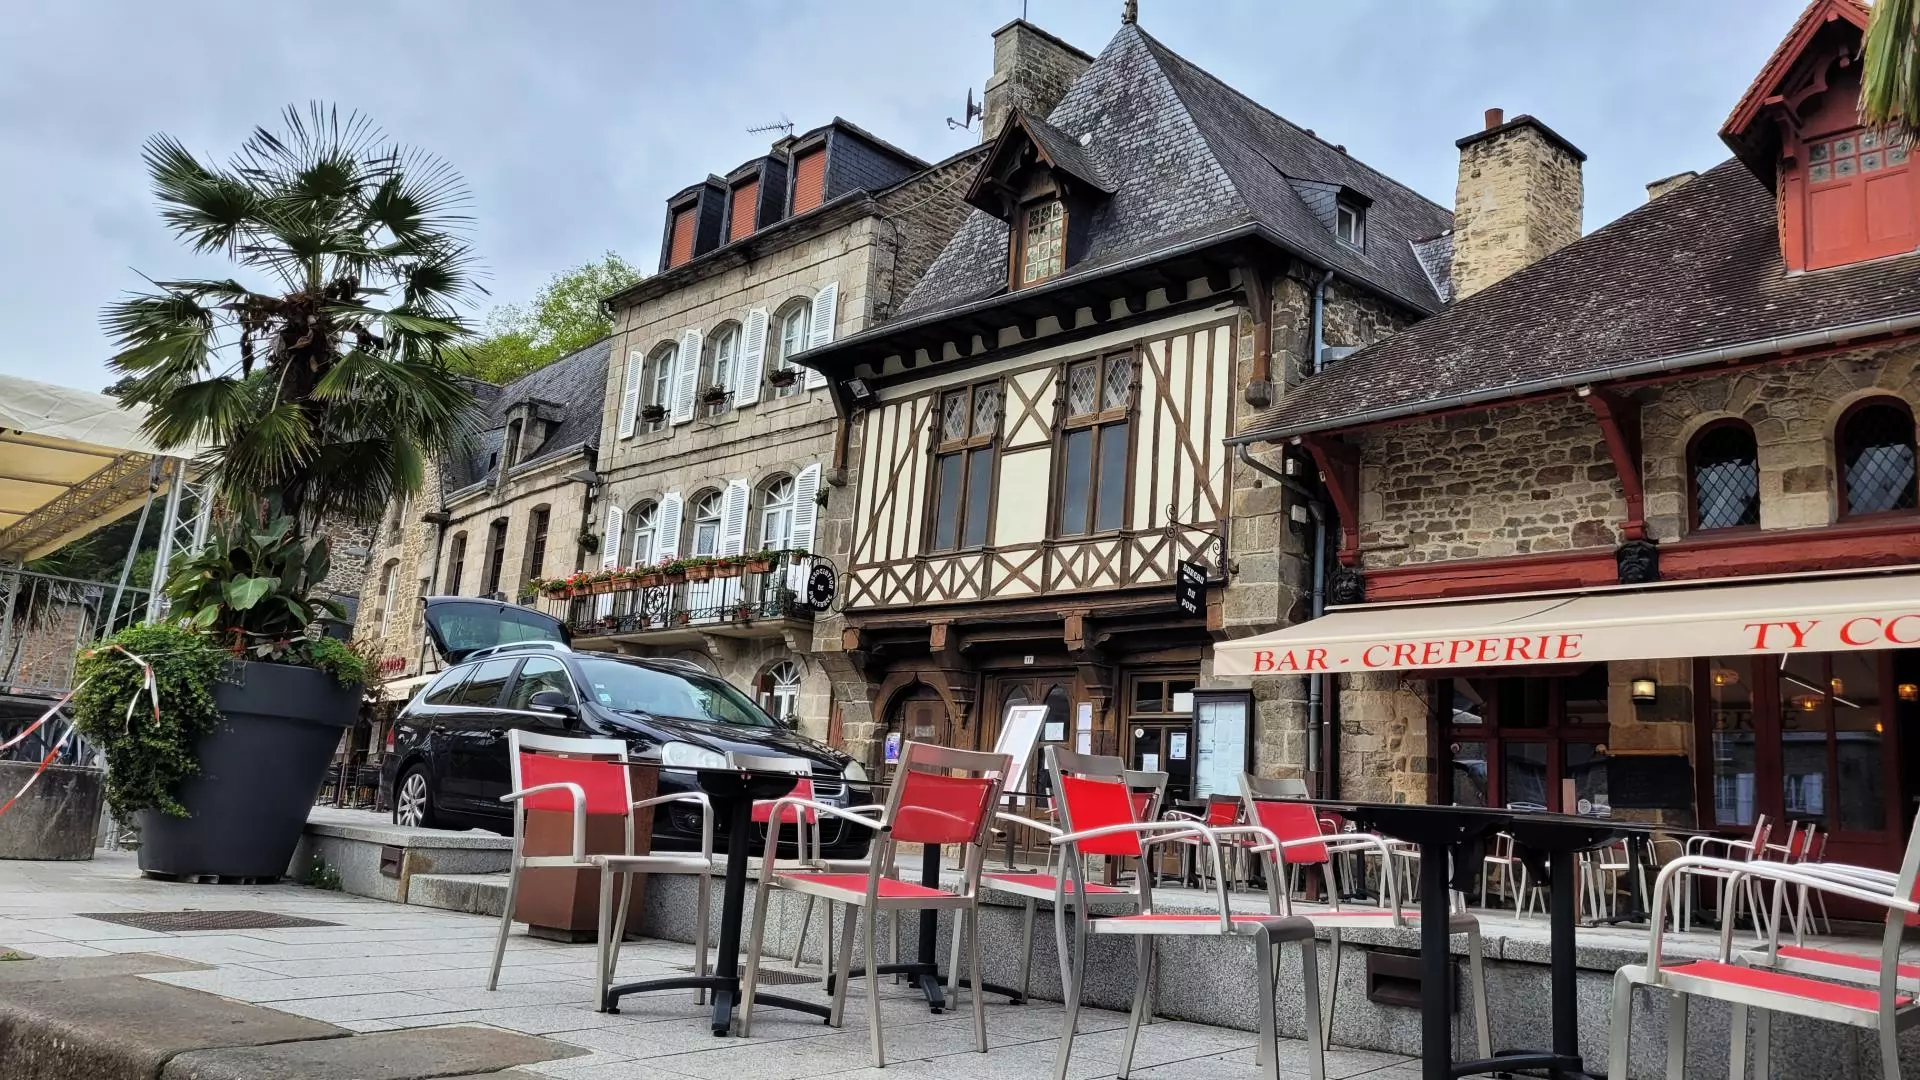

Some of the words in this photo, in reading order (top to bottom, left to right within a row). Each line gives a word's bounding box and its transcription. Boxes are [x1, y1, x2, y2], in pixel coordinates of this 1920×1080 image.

[810, 568, 833, 589] ASSOCIATION
[1182, 563, 1204, 584] BUREAU
[1187, 588, 1196, 599] DU
[1181, 598, 1197, 613] PORT
[1744, 620, 1823, 650] TY
[1253, 648, 1329, 672] BAR
[1362, 633, 1583, 668] CREPERIE
